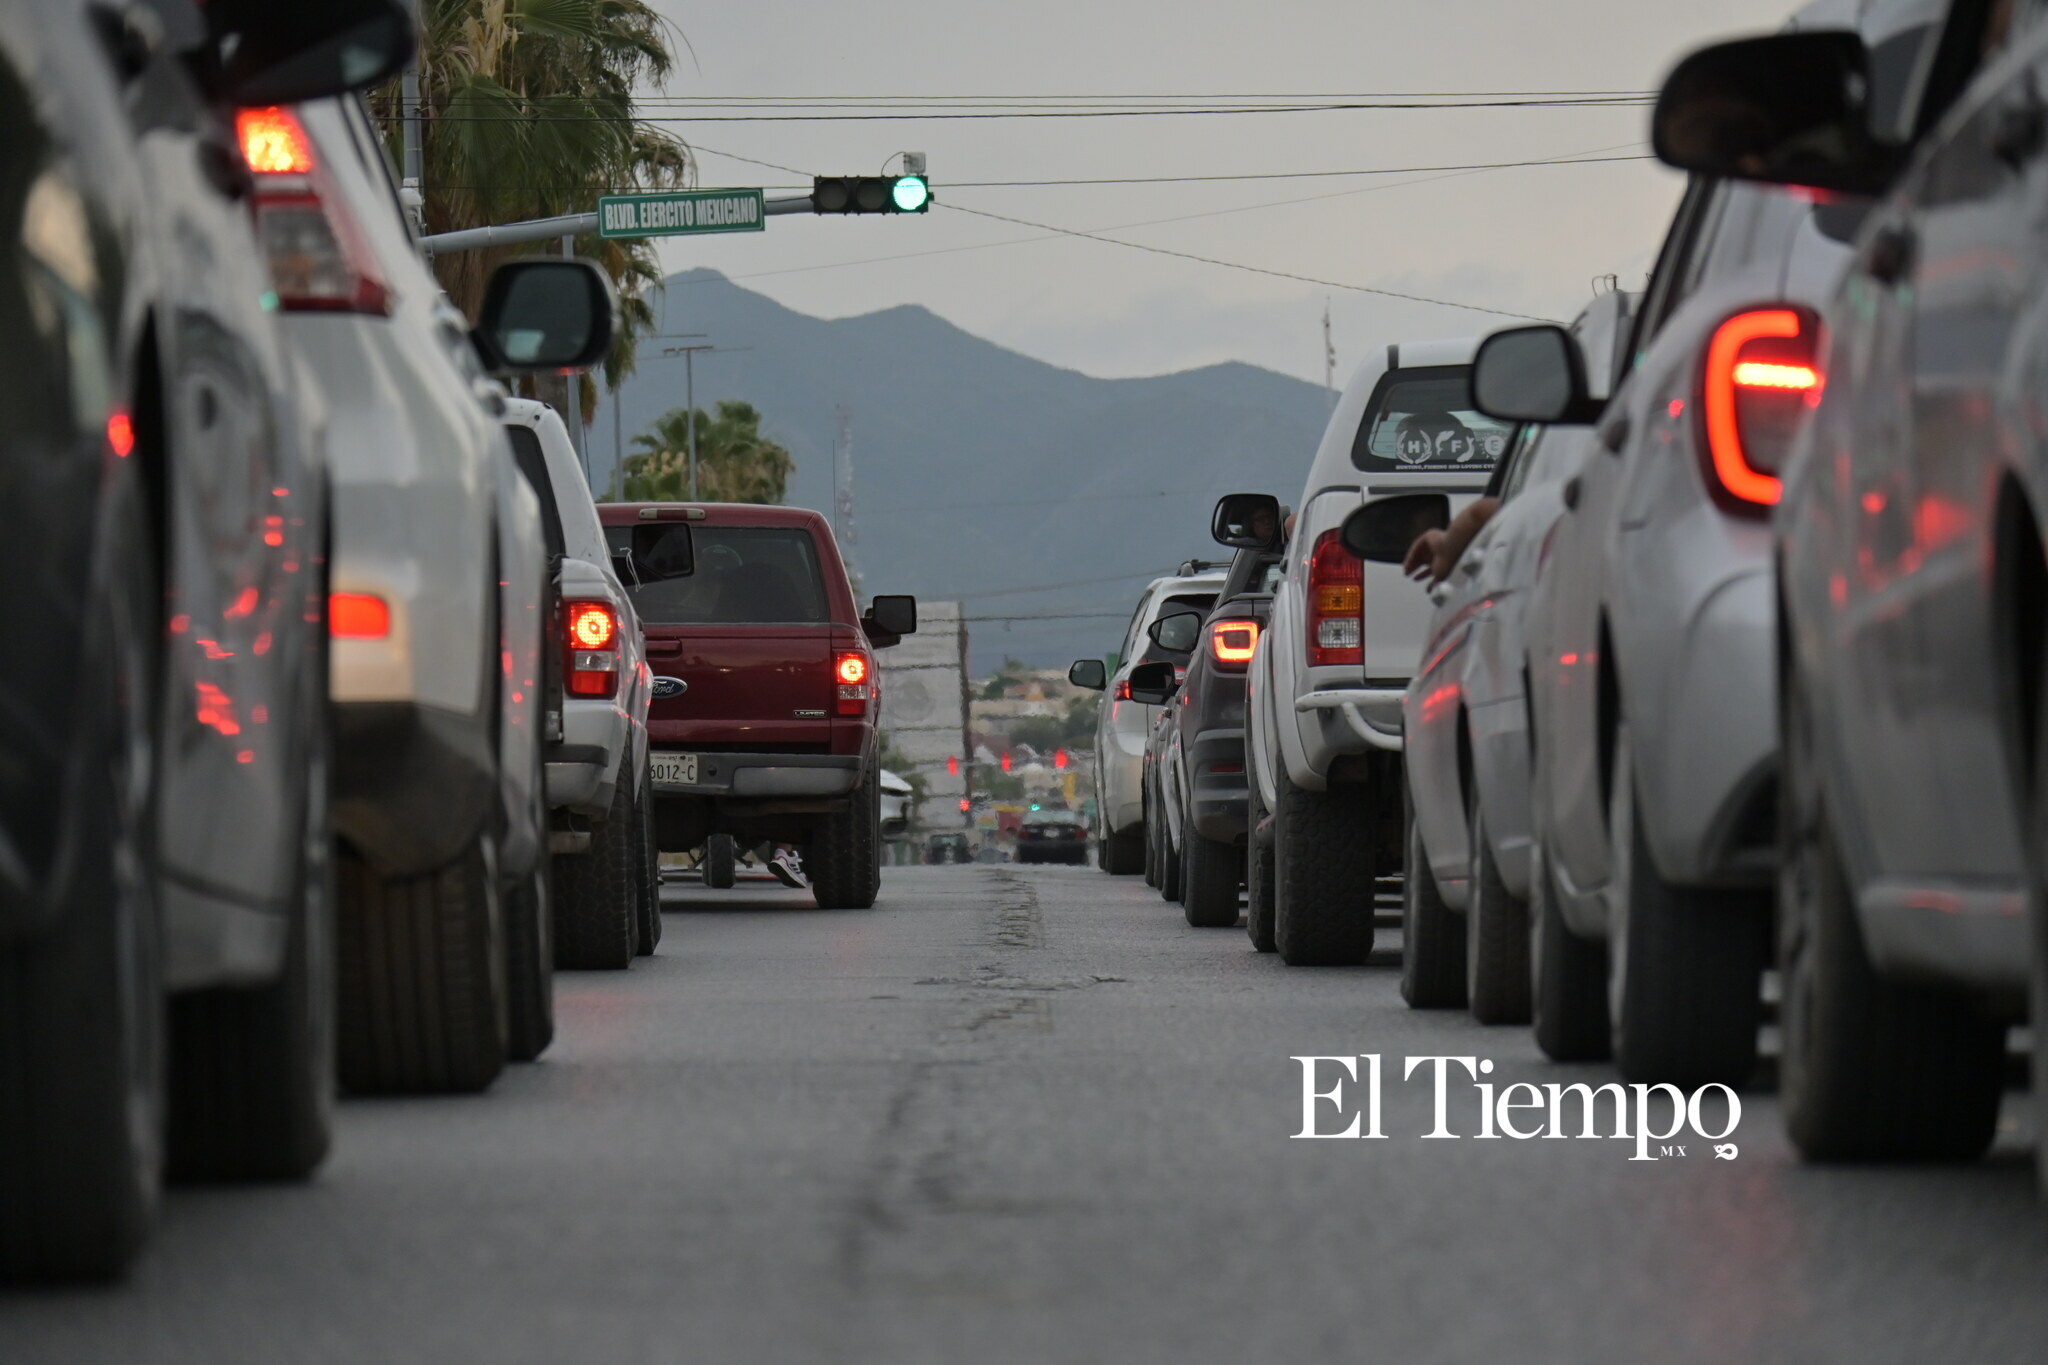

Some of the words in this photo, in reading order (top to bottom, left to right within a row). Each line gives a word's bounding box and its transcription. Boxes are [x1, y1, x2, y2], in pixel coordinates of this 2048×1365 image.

[604, 203, 639, 231] BLVD.
[640, 200, 694, 229] EJERCITO
[695, 197, 757, 226] MEXICANO
[1408, 440, 1421, 453] H
[1451, 439, 1463, 453] F
